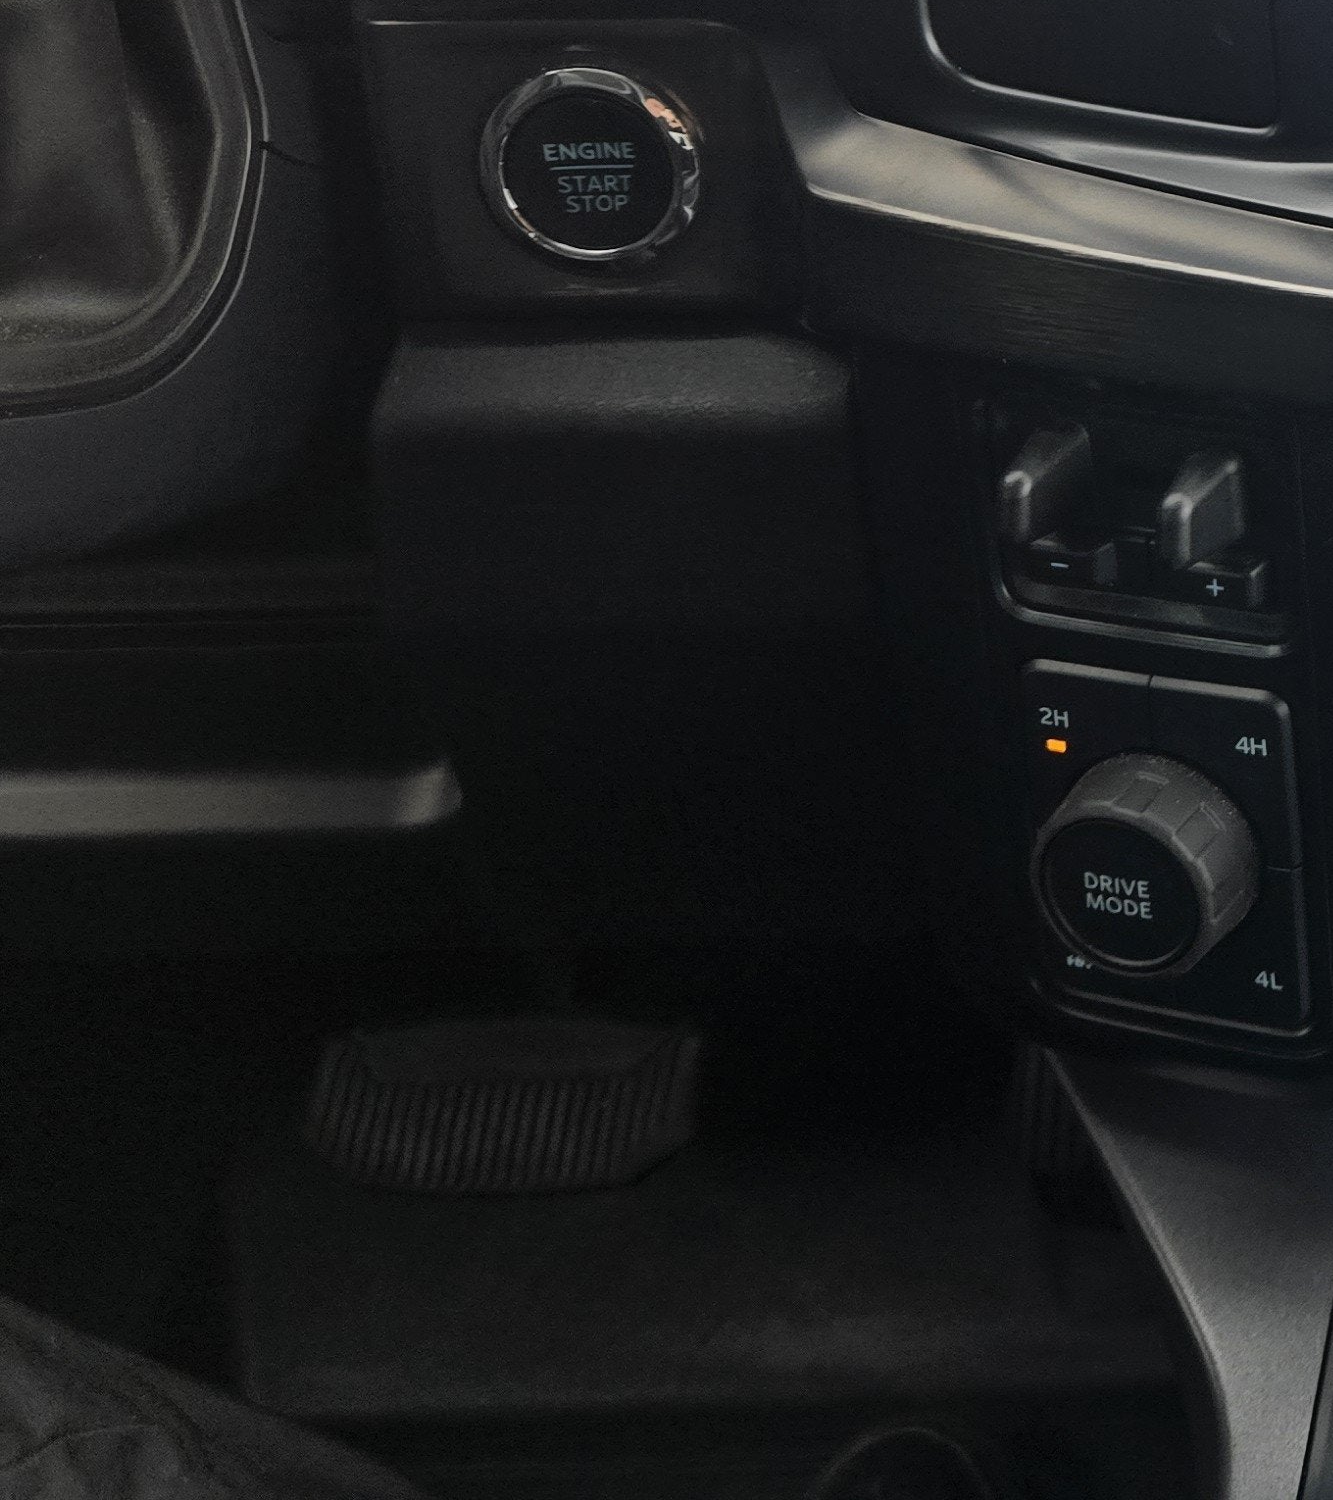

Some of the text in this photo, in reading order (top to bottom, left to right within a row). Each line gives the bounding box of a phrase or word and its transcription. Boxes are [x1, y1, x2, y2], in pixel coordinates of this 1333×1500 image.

[543, 142, 635, 161] ENGINE
[557, 175, 632, 194] START
[566, 195, 628, 213] STOP
[1039, 707, 1069, 729] 2H
[1235, 736, 1268, 757] 4H
[1083, 871, 1150, 900] DRIVE
[1085, 892, 1153, 920] MODE
[1254, 971, 1284, 989] 4L
